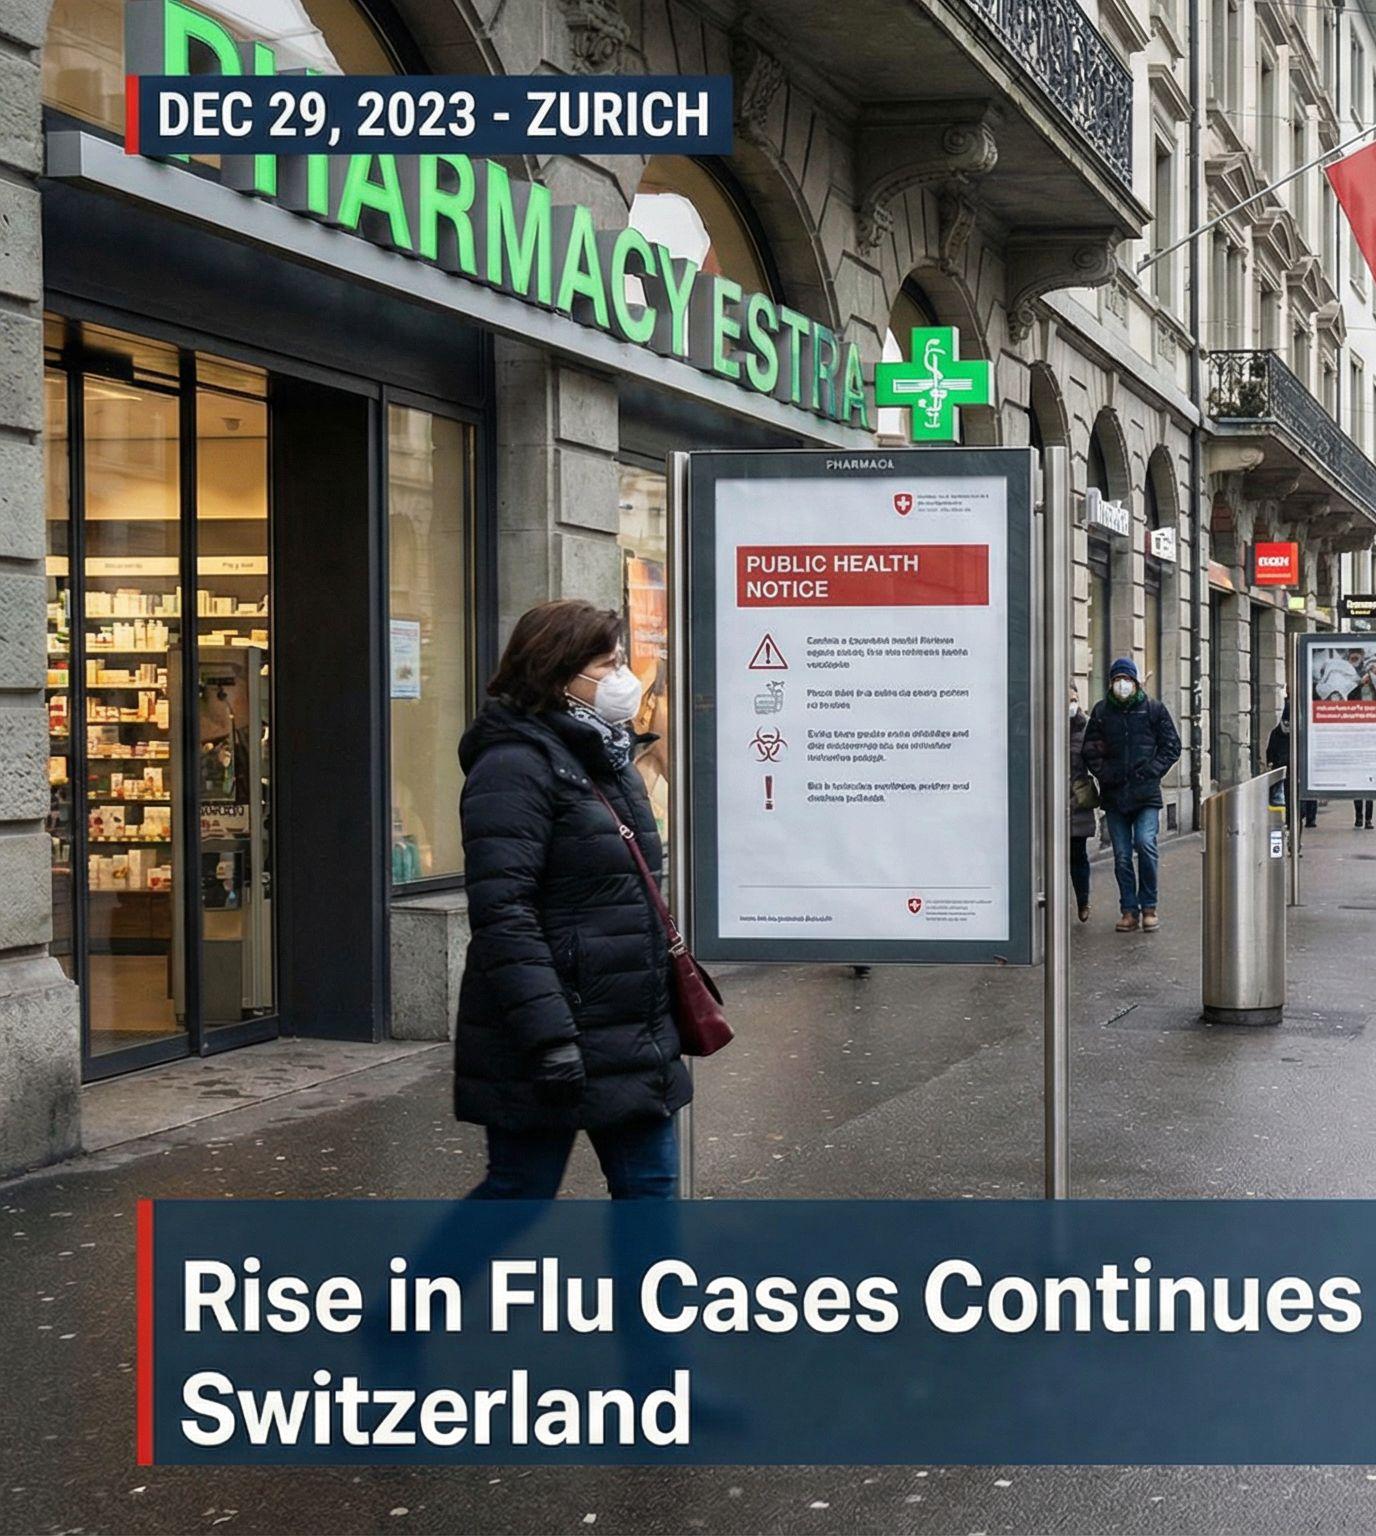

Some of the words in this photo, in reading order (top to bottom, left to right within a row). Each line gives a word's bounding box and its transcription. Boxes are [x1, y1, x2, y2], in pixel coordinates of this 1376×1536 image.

[713, 277, 870, 430] ESTRA
[746, 554, 827, 573] PUBLIC
[833, 554, 919, 573] HEALTH
[746, 580, 829, 599] NOTICE
